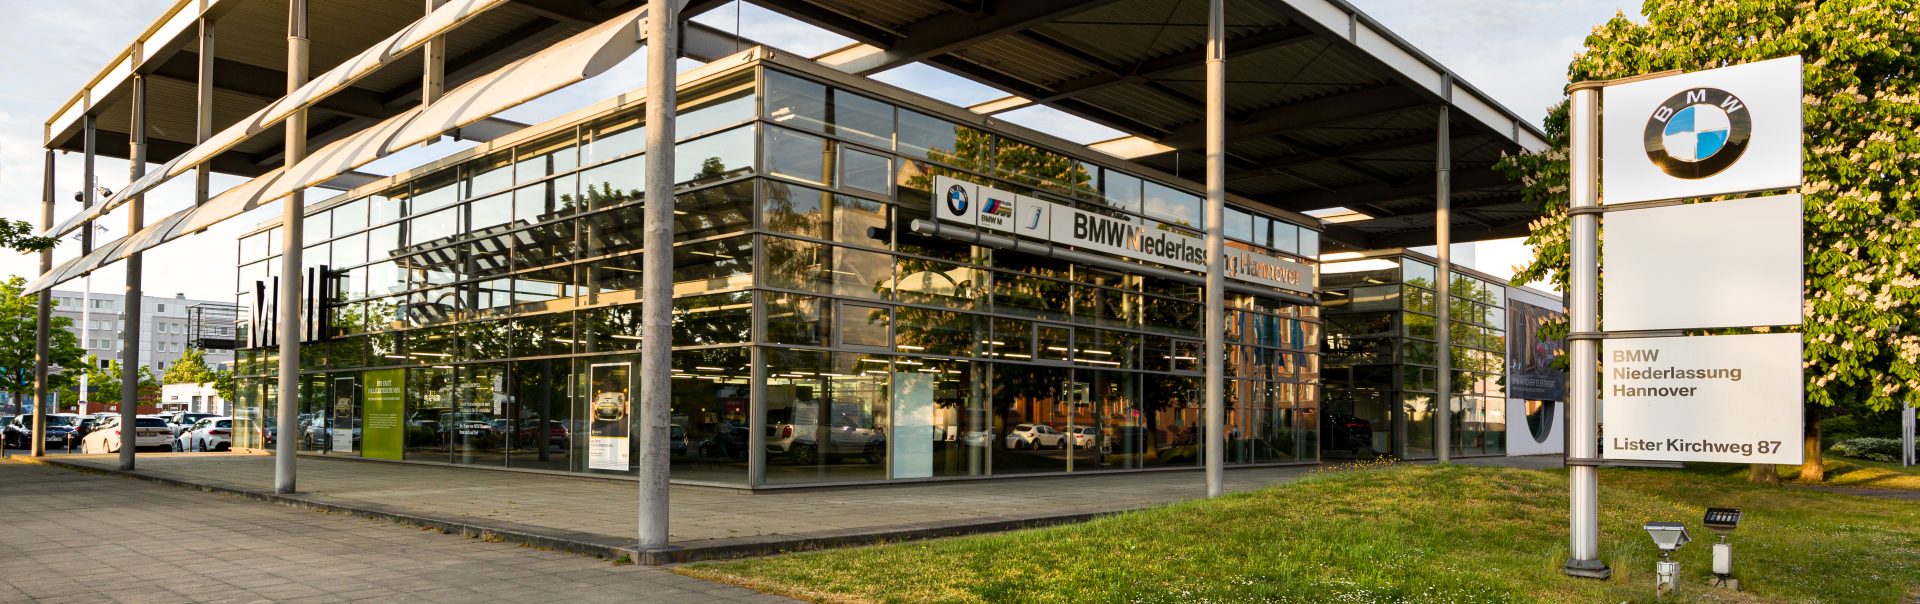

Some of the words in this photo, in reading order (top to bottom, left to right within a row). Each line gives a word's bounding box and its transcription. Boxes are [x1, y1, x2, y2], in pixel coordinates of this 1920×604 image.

[1653, 89, 1743, 123] BMW
[981, 214, 997, 224] BMW
[996, 217, 1003, 226] M
[1074, 211, 1126, 250] BMW
[1126, 224, 1238, 278] Niederlassng
[1240, 251, 1300, 287] Hannover
[1612, 349, 1659, 363] BMW
[1612, 366, 1742, 382] Niederlassung
[1612, 384, 1697, 397] Hannover
[1613, 437, 1663, 451] Lister
[1666, 438, 1753, 457] Kirchweg
[1757, 440, 1782, 454] 87
